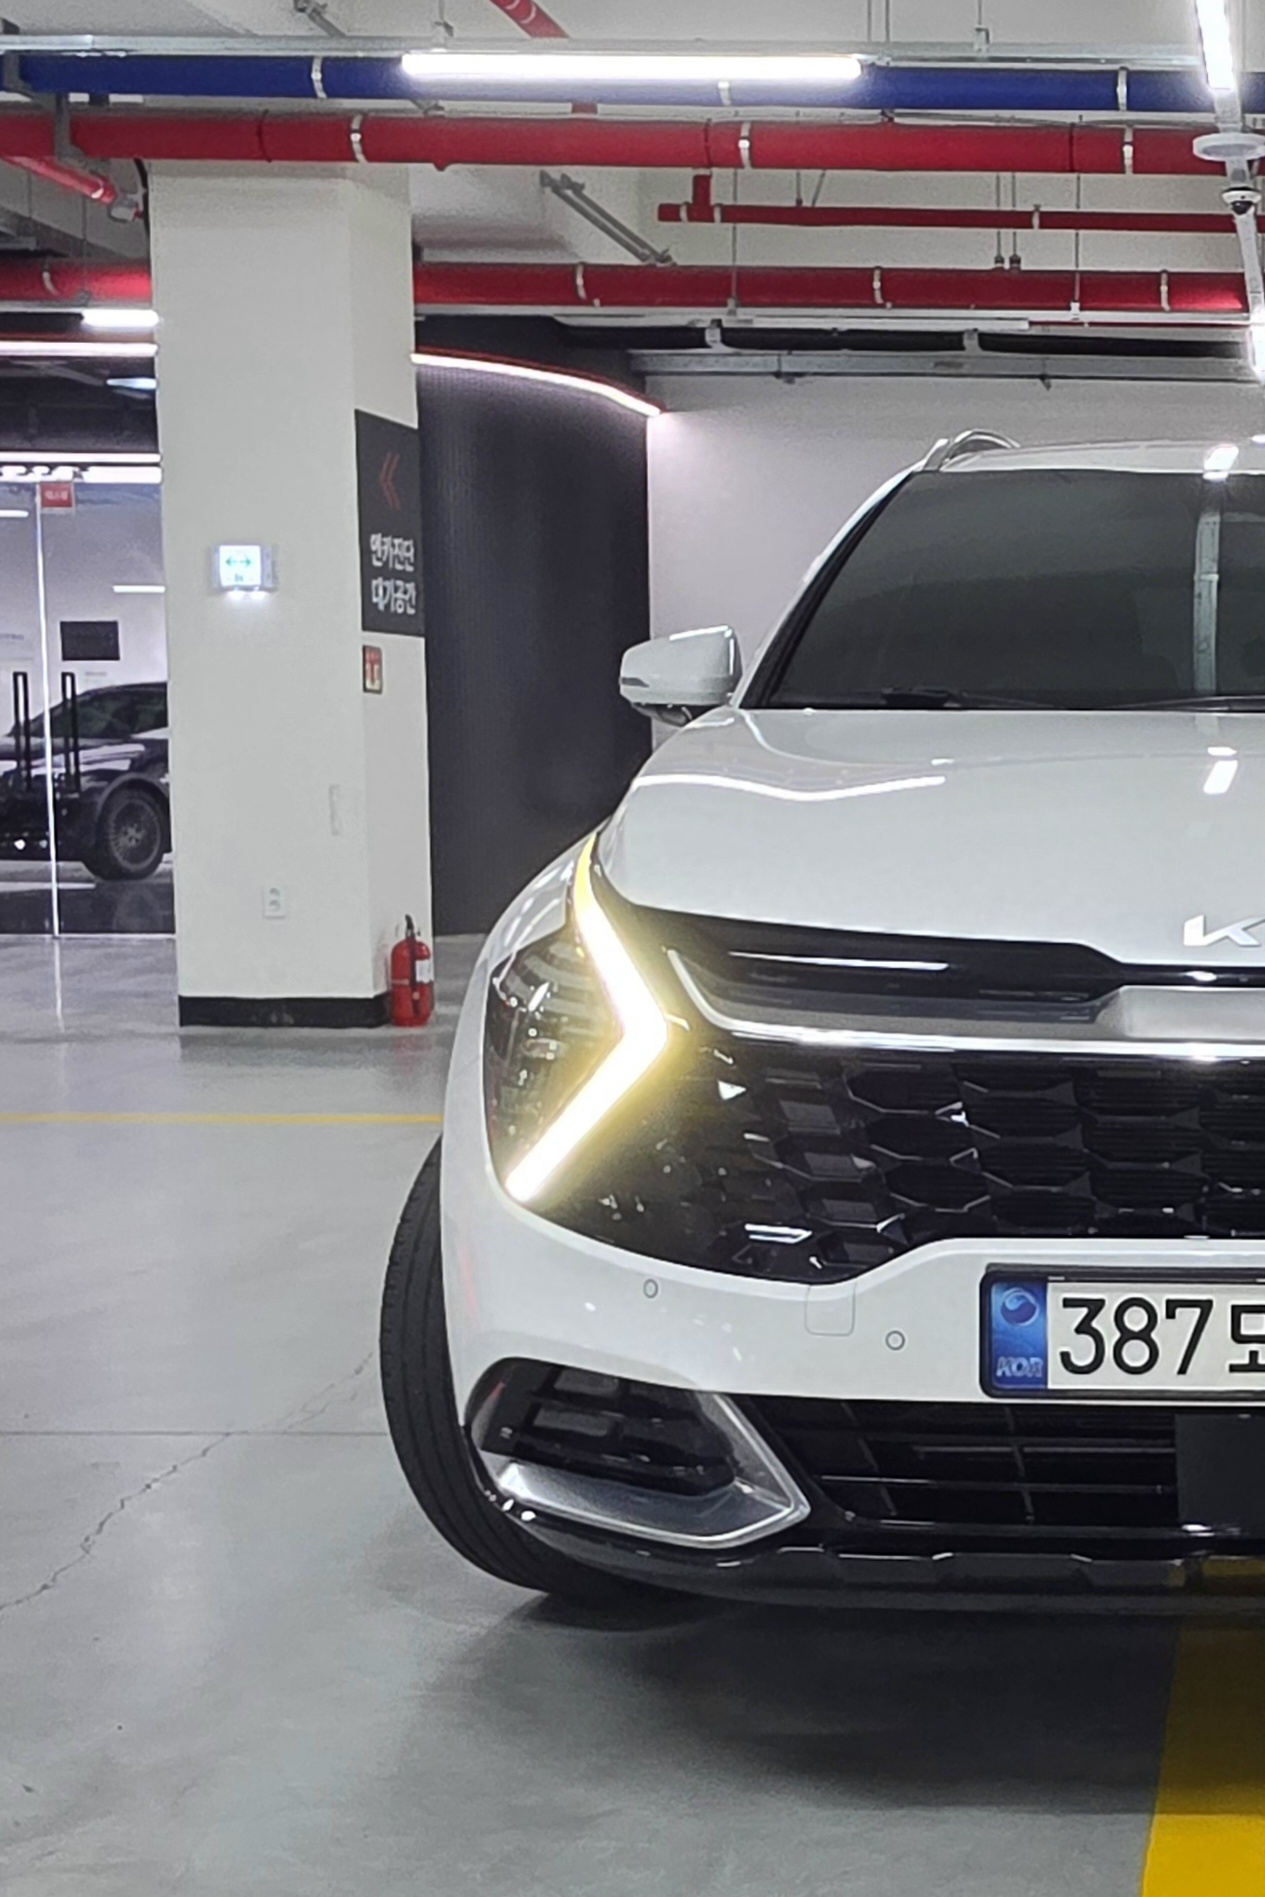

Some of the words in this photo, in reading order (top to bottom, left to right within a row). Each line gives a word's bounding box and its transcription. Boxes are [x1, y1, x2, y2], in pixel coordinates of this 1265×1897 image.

[370, 533, 415, 572] 엔카진단
[371, 577, 416, 614] 대기공간
[996, 1357, 1044, 1378] KOR
